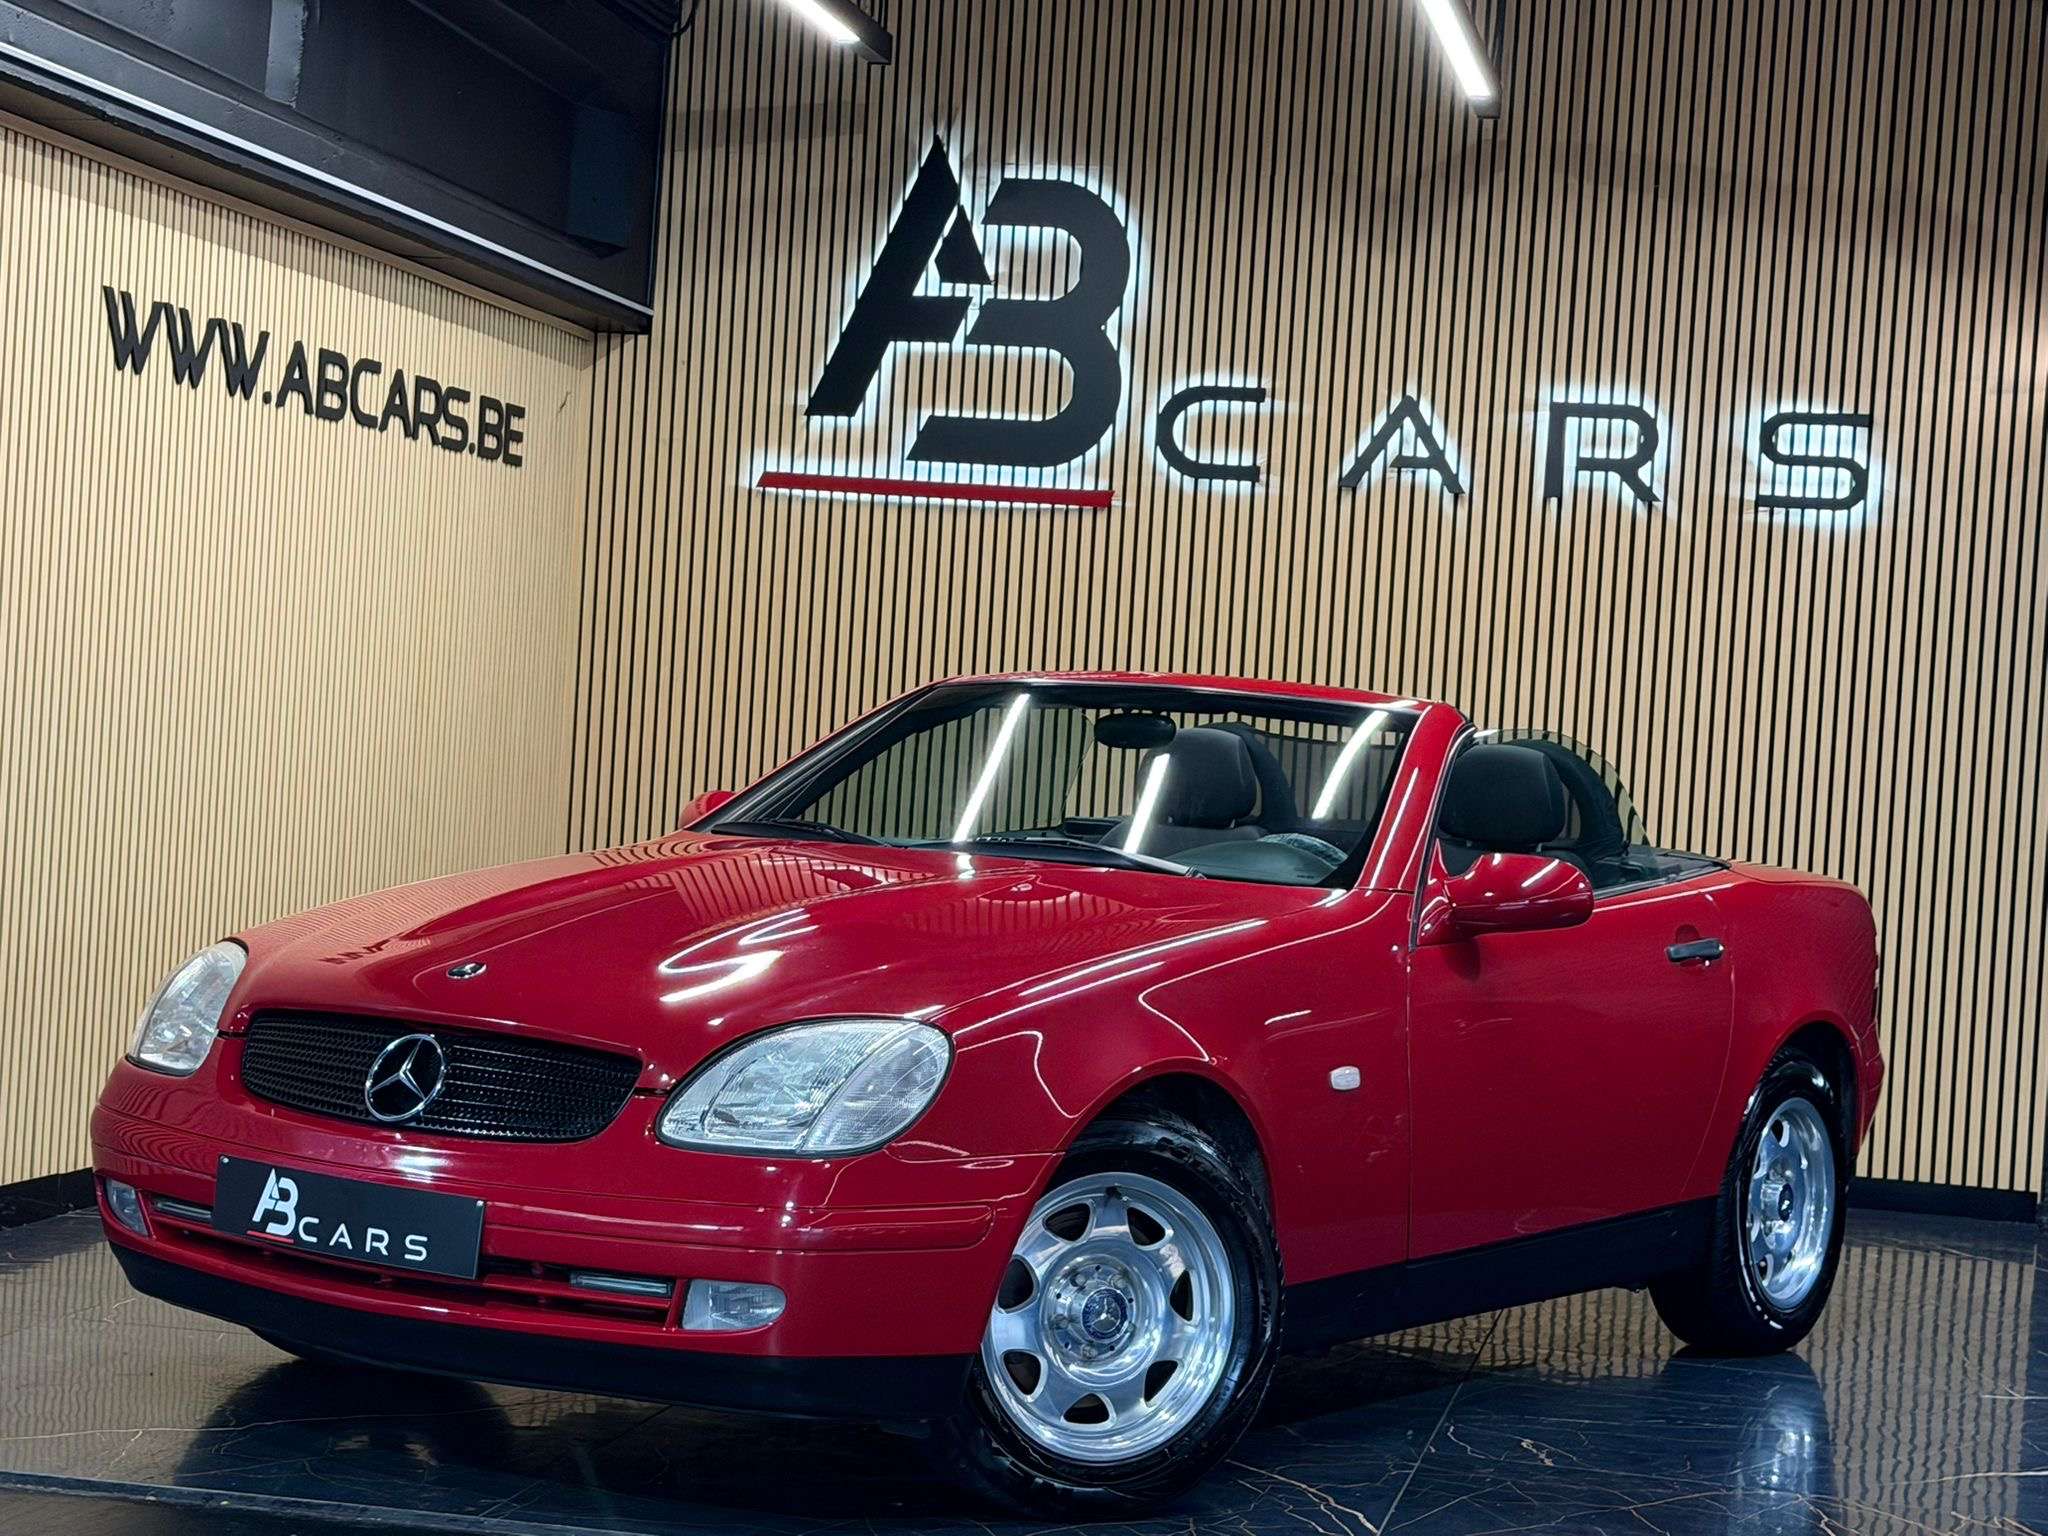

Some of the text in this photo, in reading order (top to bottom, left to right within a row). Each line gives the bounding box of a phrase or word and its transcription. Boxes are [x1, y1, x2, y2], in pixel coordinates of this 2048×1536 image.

[102, 285, 525, 467] WWW.ABCARS.BE
[804, 134, 1872, 511] AB CARS
[252, 1168, 428, 1261] AB CARS
